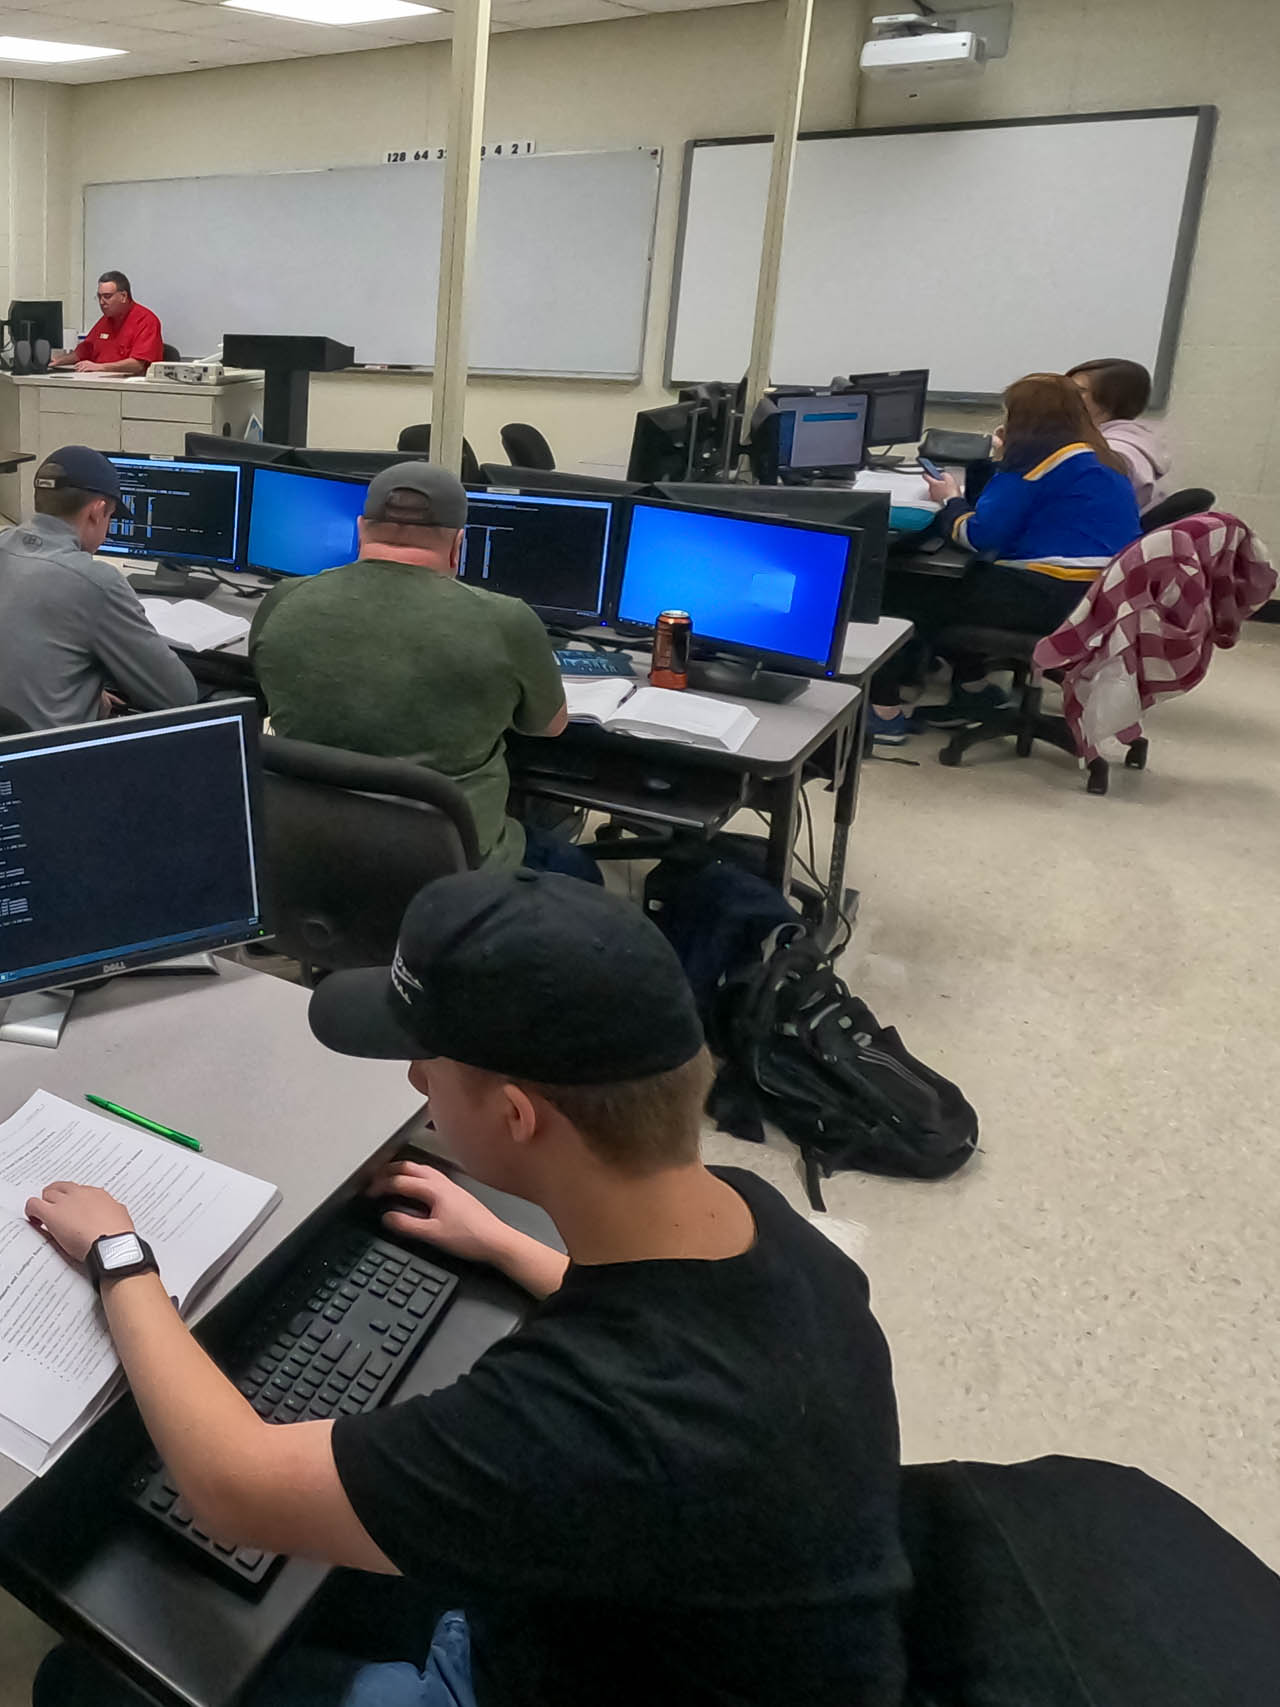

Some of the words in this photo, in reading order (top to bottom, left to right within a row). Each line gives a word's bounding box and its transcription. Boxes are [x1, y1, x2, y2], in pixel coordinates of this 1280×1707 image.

[387, 152, 406, 163] 128
[414, 150, 429, 161] 64
[437, 149, 447, 160] 3
[495, 145, 502, 155] 4
[512, 144, 518, 154] 2
